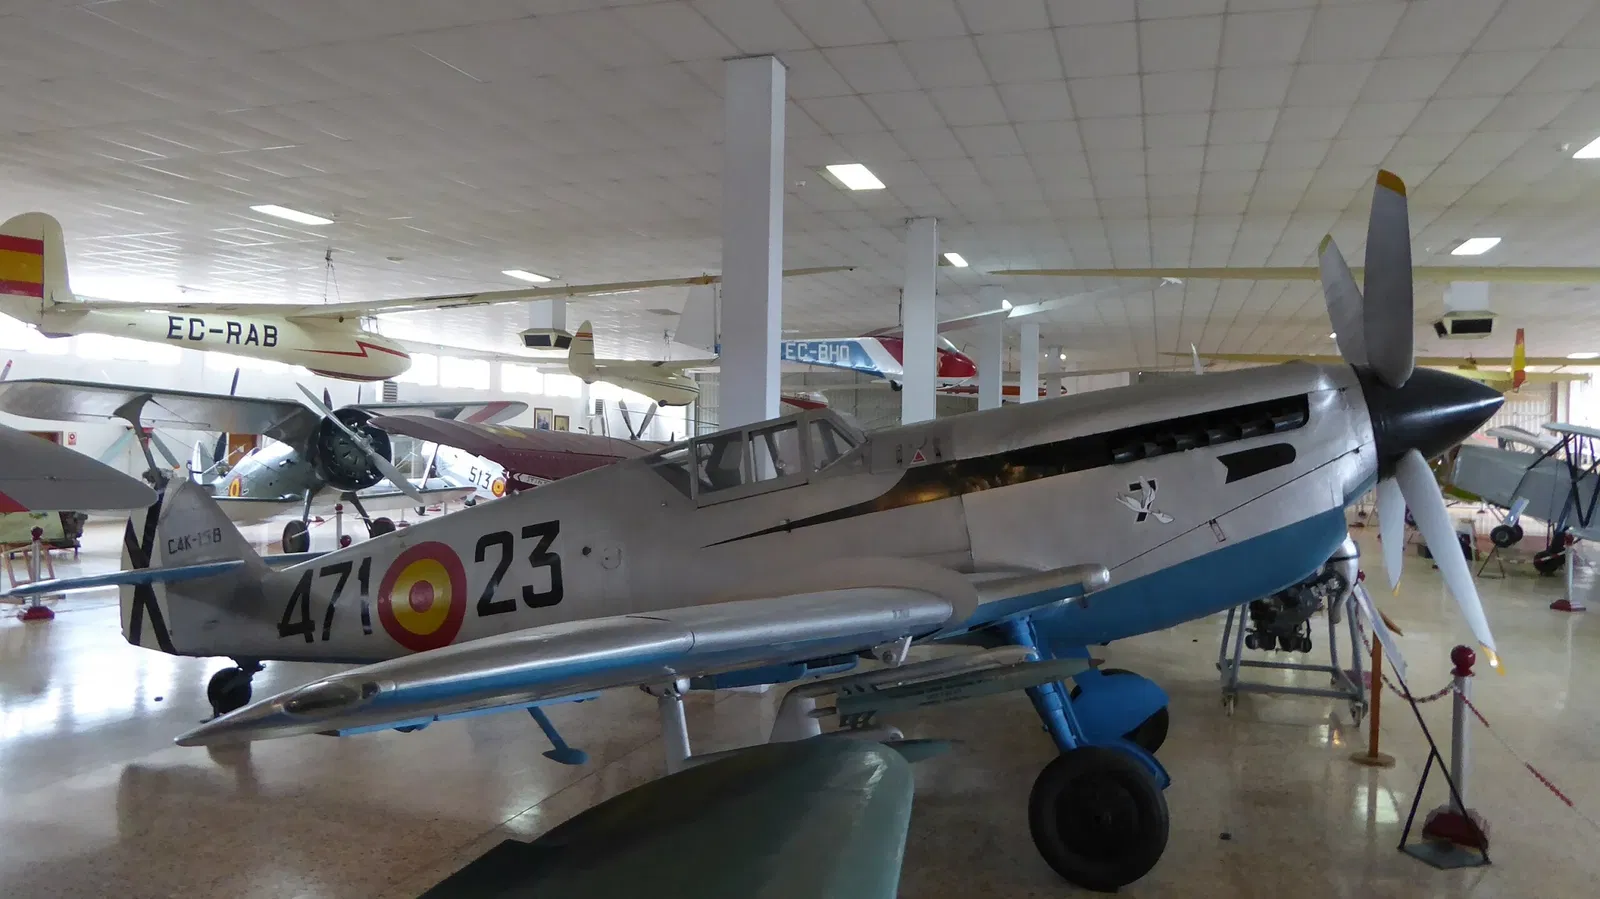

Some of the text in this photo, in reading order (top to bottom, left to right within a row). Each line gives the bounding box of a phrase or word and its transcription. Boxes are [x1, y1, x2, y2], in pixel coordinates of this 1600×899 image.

[166, 315, 278, 347] EC-RAB
[469, 465, 492, 490] 513
[277, 519, 564, 643] 471 23
